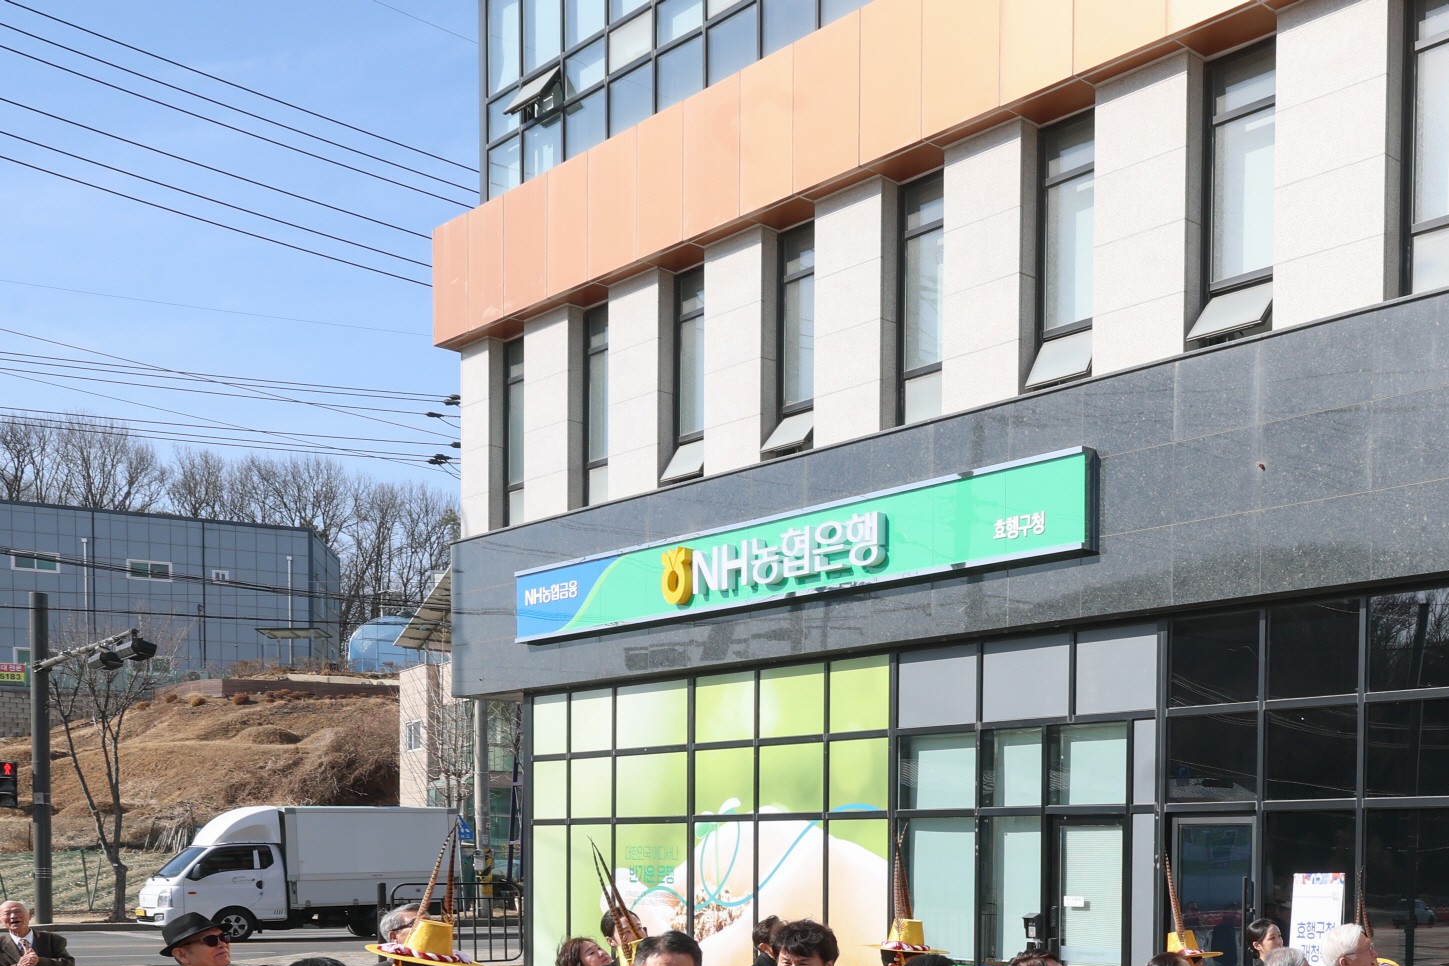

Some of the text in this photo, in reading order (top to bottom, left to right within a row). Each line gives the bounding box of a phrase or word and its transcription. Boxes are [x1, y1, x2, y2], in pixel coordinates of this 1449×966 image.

[992, 510, 1046, 540] 효행구청
[692, 511, 884, 595] NH농협은행
[524, 580, 578, 607] NH농협금융
[1301, 944, 1322, 963] 개청
